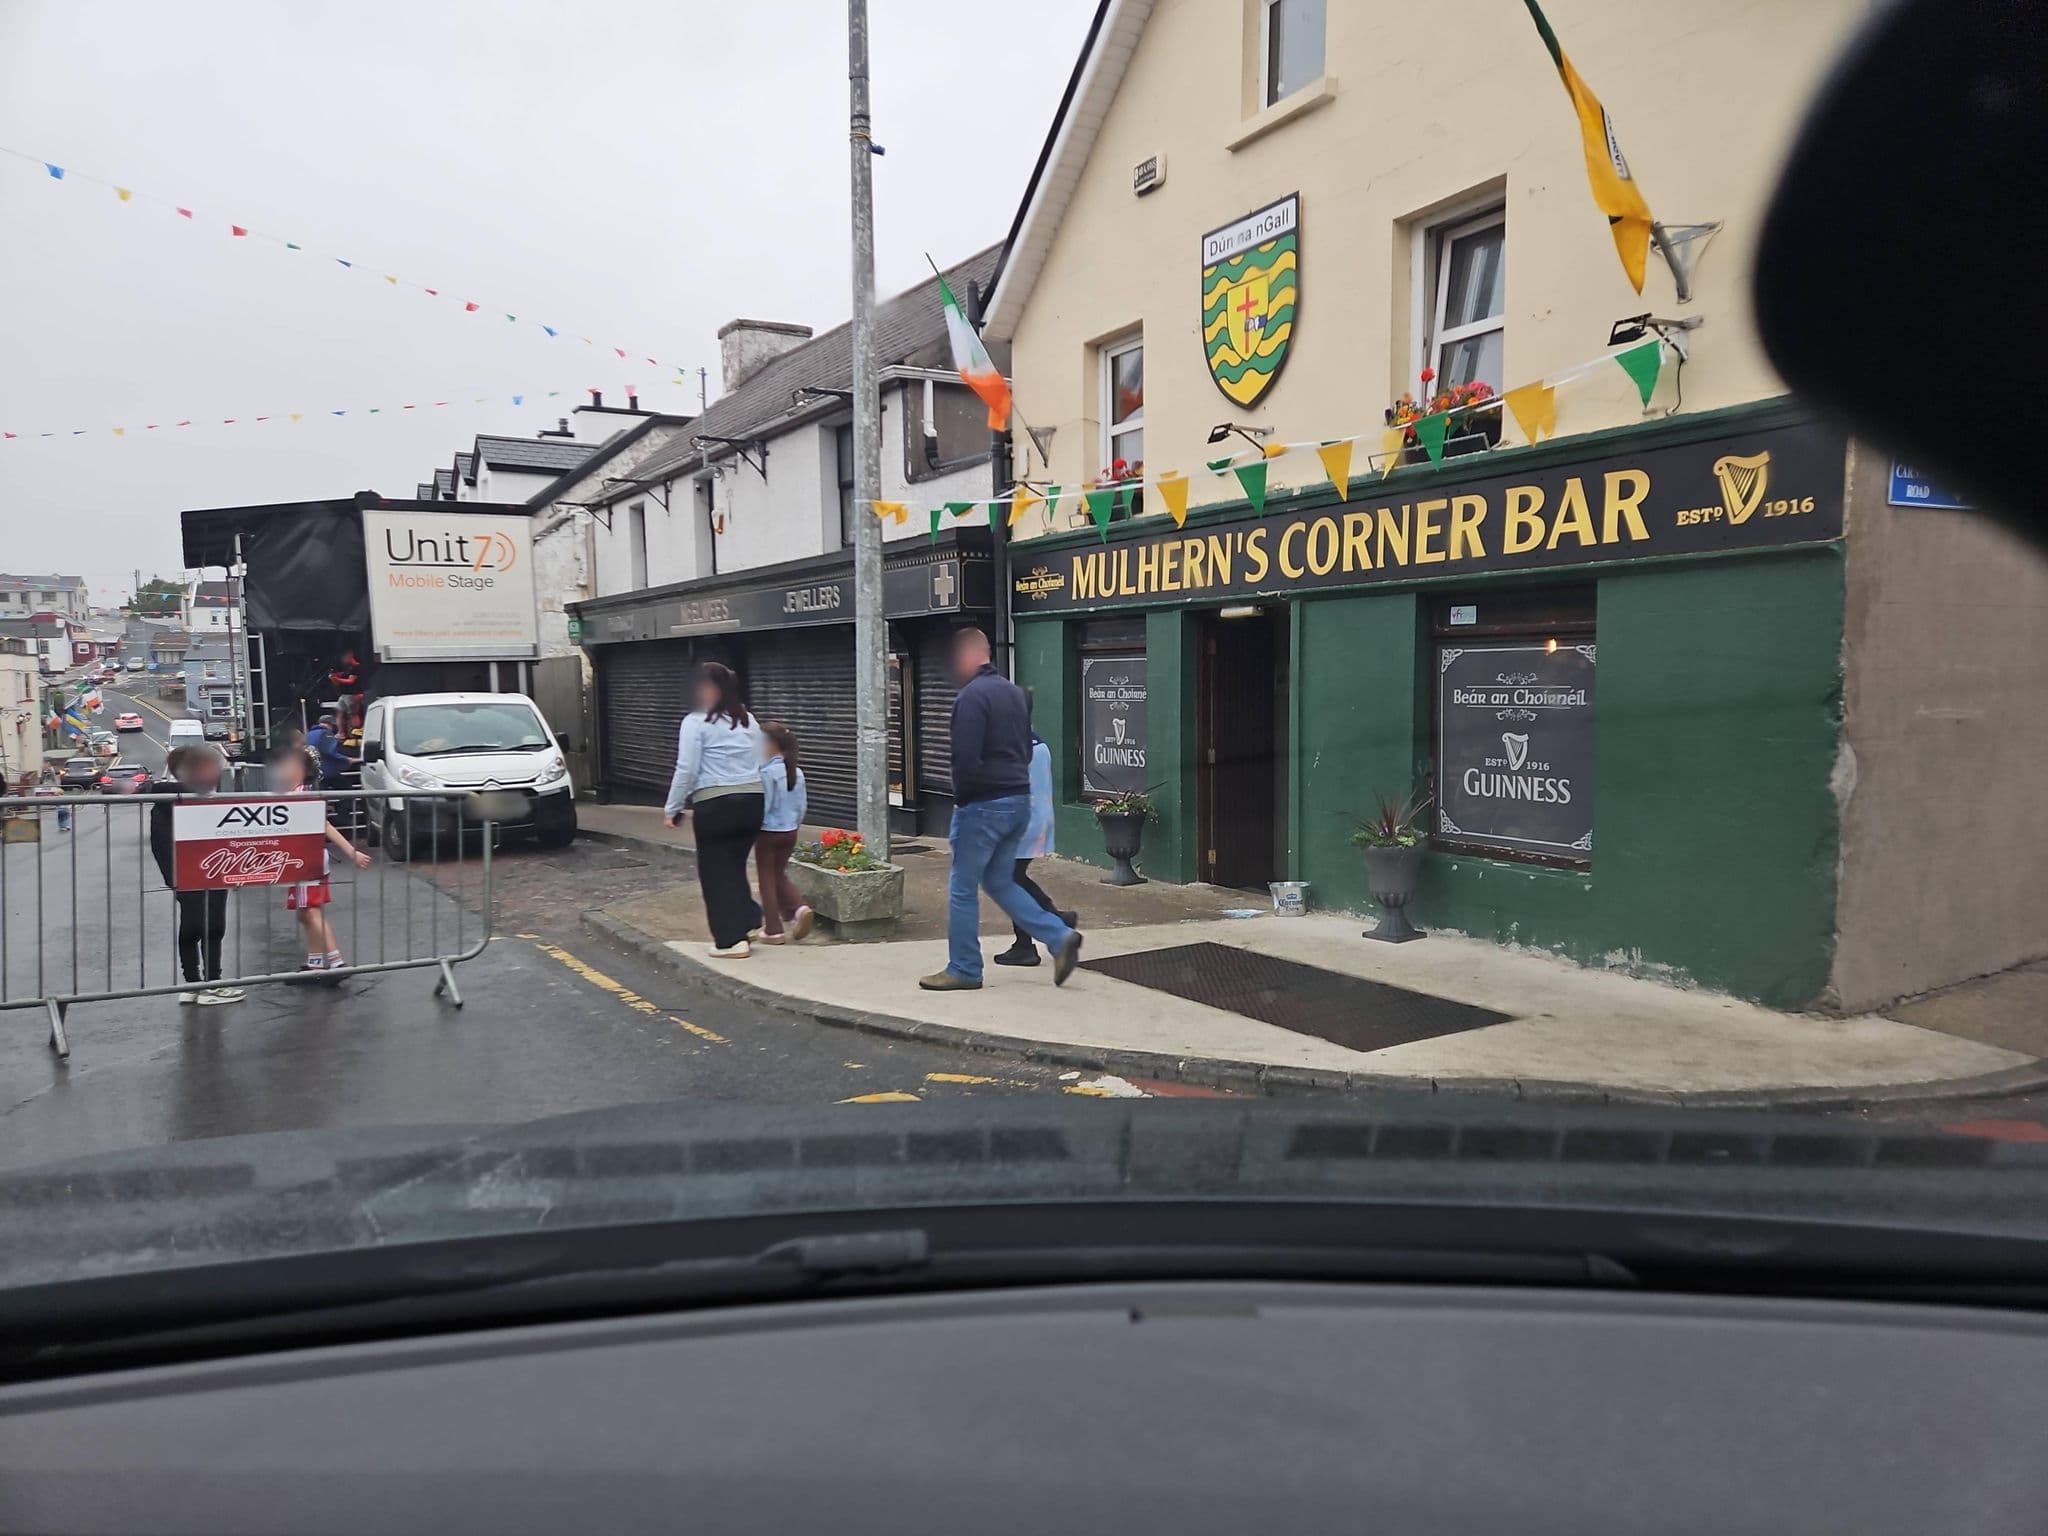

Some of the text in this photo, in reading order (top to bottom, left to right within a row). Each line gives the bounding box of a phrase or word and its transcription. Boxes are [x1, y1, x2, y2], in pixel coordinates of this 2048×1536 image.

[1209, 207, 1289, 257] Dún na nGall
[1906, 484, 1930, 498] ROAD
[1764, 496, 1815, 518] 1916
[1072, 469, 1652, 601] MULHERN'S CORNER BAR
[389, 573, 494, 591] Mobile Stage
[783, 585, 841, 614] JEWELLERS
[1107, 690, 1116, 698] an
[1453, 689, 1587, 706] Beár an Choirnéil
[1095, 743, 1146, 767] GUINNESS
[1526, 761, 1551, 771] 1916
[1464, 768, 1572, 804] GUINNESS
[216, 804, 290, 828] AXIS
[229, 838, 280, 848] Sponsoring
